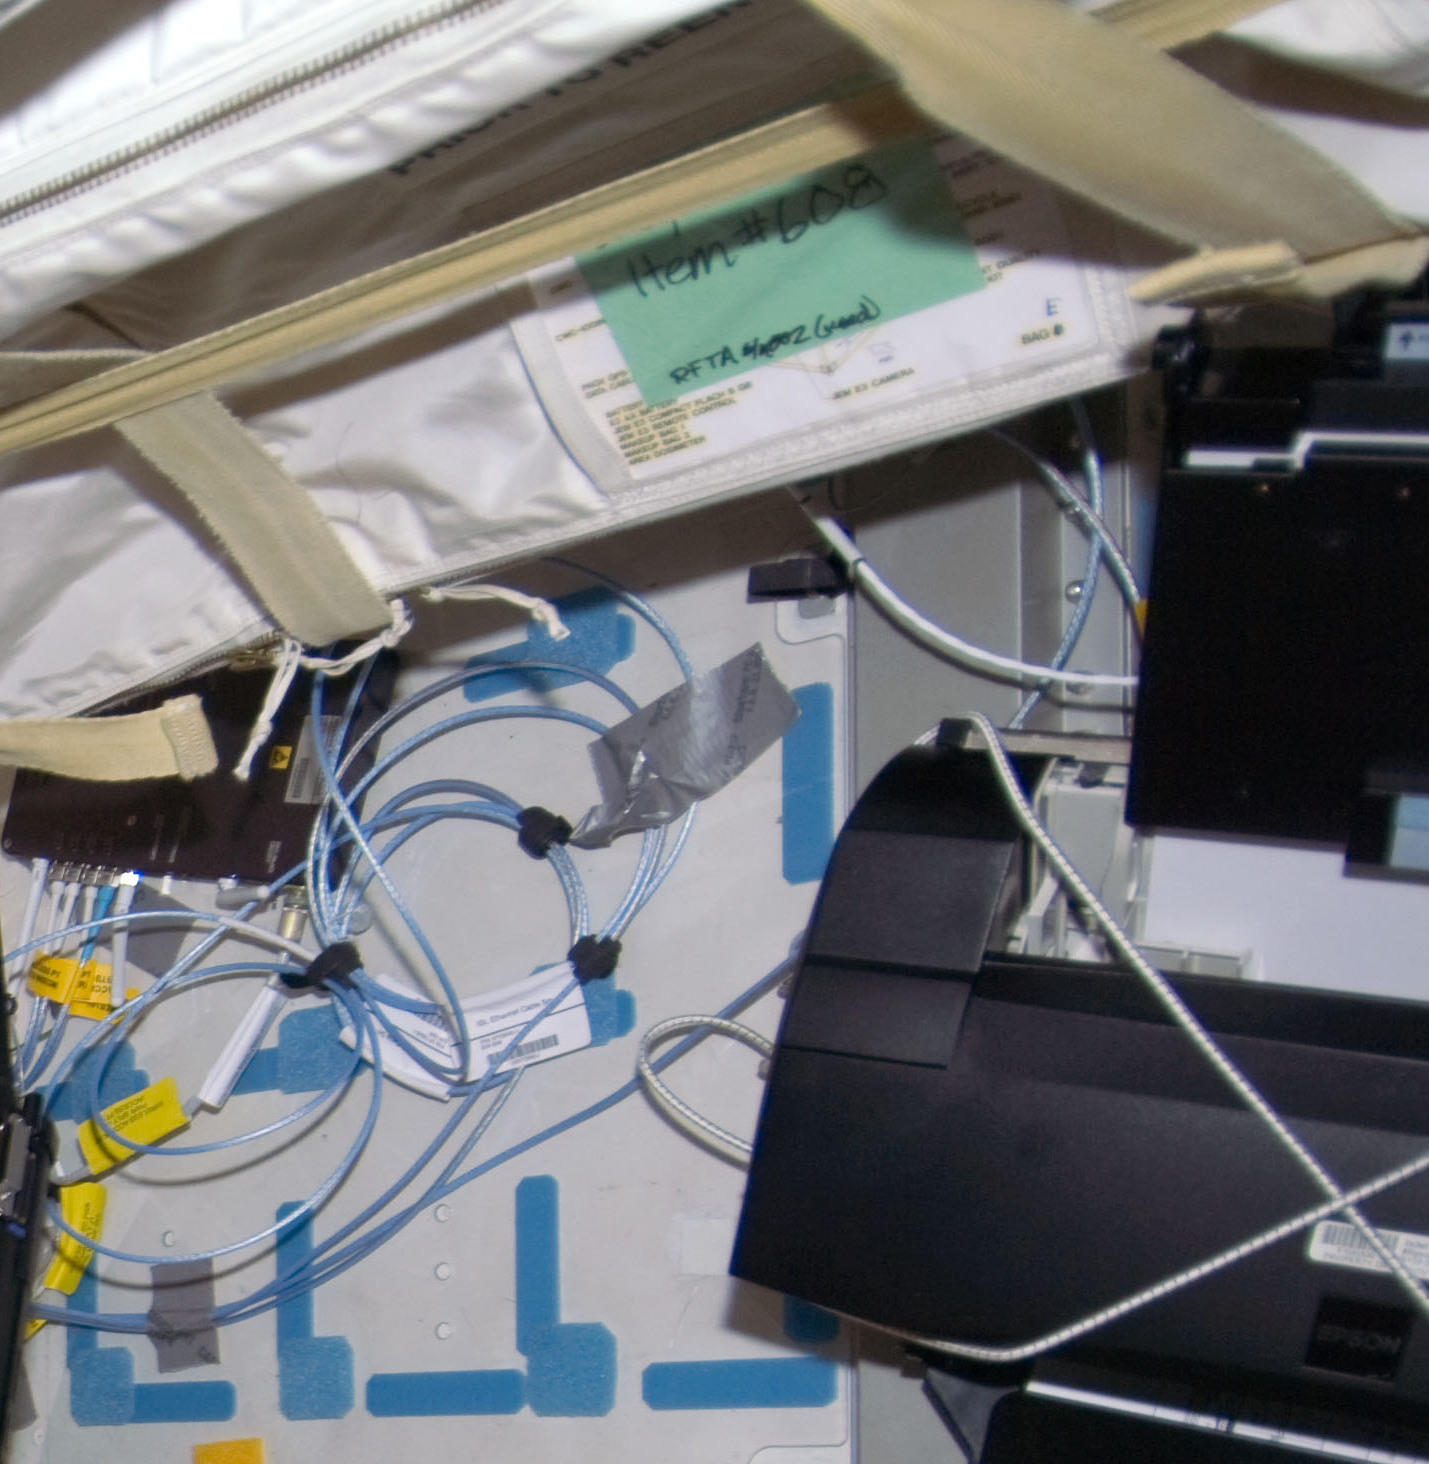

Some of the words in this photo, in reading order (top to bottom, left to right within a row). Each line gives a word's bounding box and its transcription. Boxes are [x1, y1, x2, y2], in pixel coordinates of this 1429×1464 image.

[1021, 329, 1050, 346] BAG
[669, 346, 740, 385] RFTA
[871, 367, 916, 388] CAMERA
